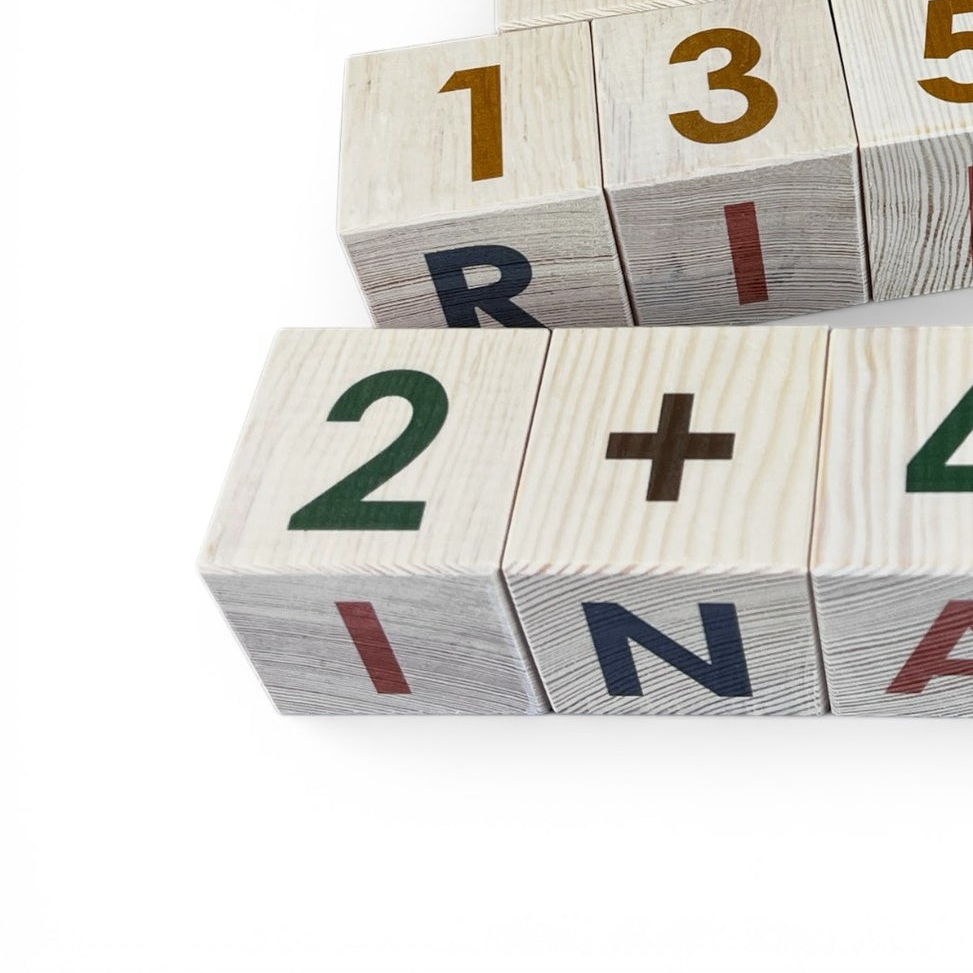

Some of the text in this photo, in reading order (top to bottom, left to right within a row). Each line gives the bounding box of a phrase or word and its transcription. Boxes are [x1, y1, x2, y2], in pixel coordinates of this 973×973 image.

[438, 65, 504, 182] 1
[668, 27, 779, 144] 3
[425, 244, 549, 327] R
[724, 201, 769, 306] I
[287, 369, 450, 532] 2
[335, 601, 412, 695] I
[581, 601, 754, 697] N
